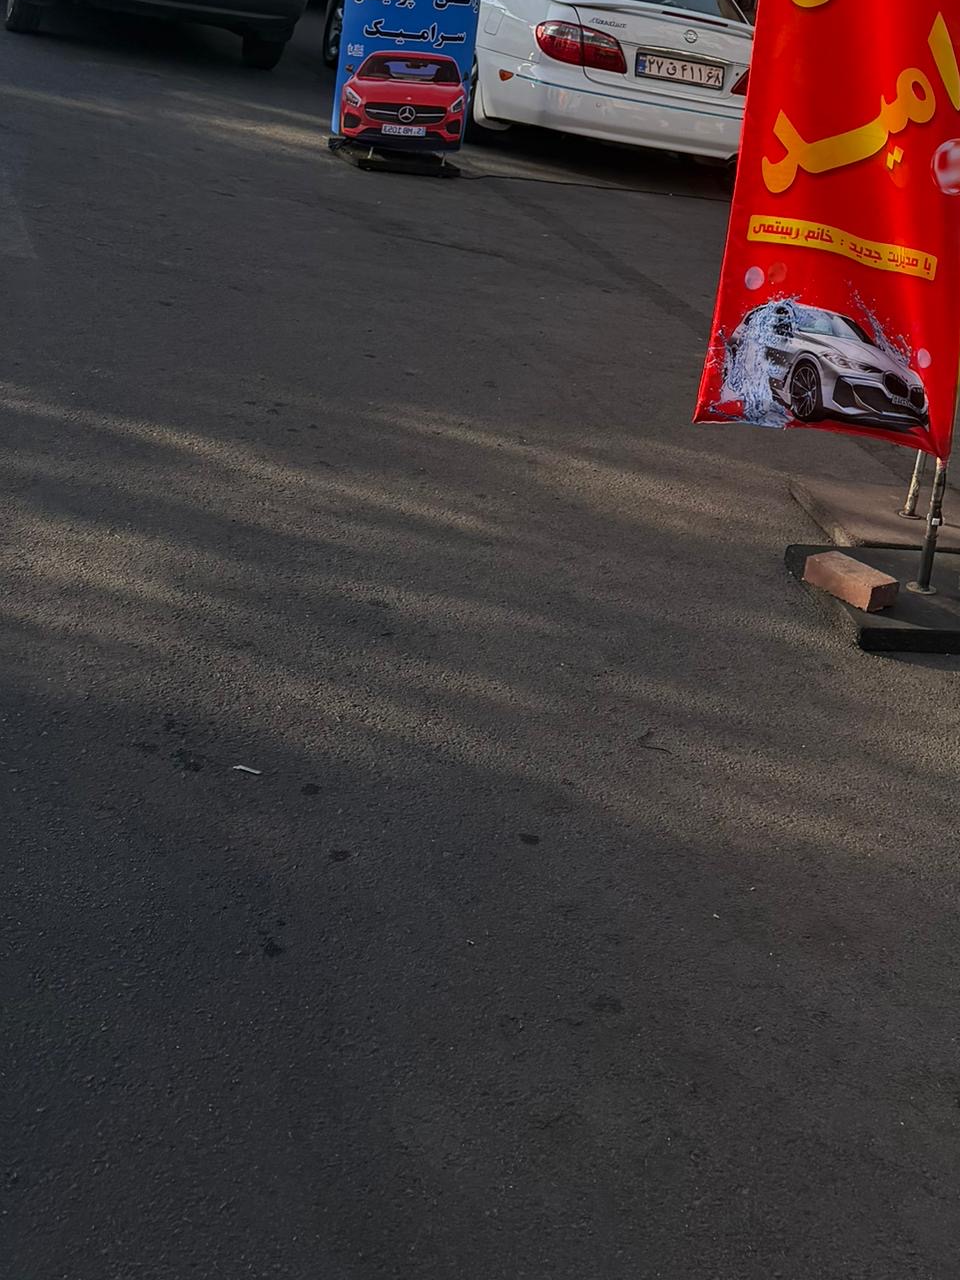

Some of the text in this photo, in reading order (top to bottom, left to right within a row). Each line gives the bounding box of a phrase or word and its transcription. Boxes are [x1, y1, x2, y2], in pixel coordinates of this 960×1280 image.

[363, 19, 467, 49] سرامیک
[805, 227, 834, 244] خانم
[849, 241, 883, 263] جدید
